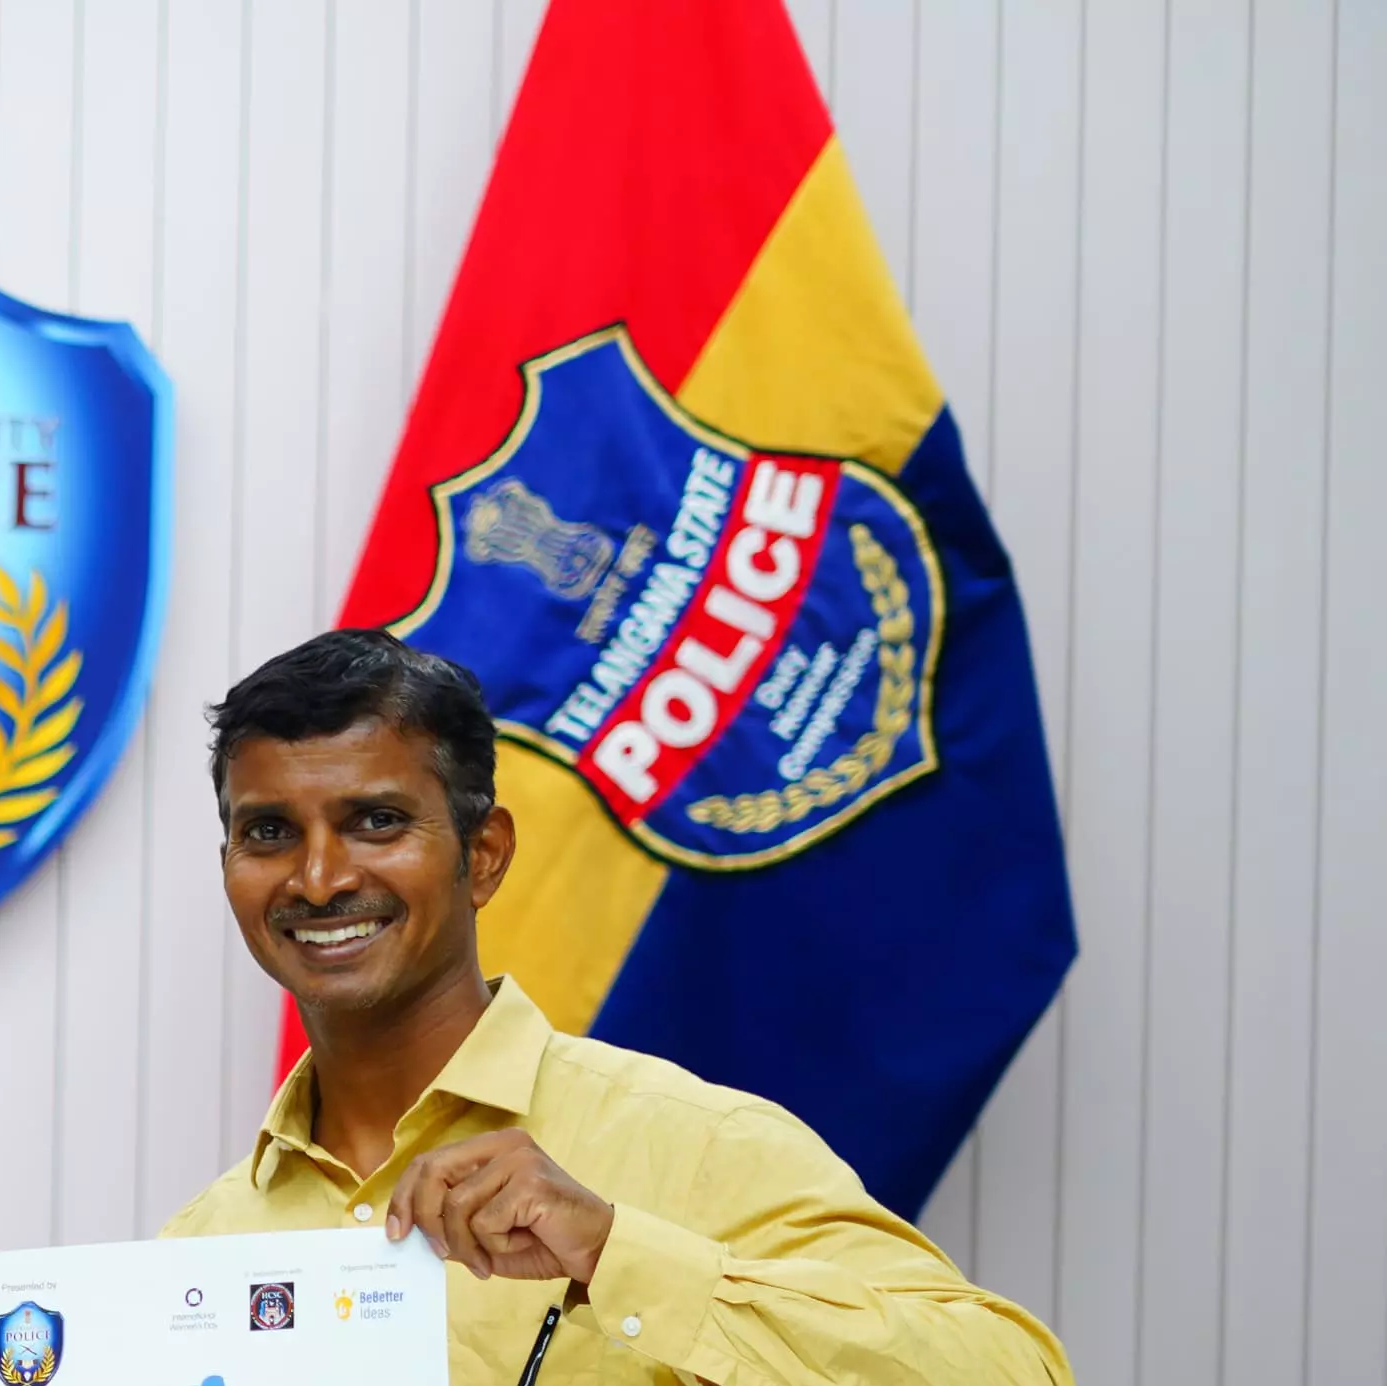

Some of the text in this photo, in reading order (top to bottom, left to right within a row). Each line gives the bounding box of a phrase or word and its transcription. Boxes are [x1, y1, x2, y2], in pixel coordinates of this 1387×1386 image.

[545, 562, 703, 742] TELANGANA
[666, 448, 735, 568] STATE
[593, 460, 824, 804] POLICE
[5, 1329, 51, 1342] POLICE
